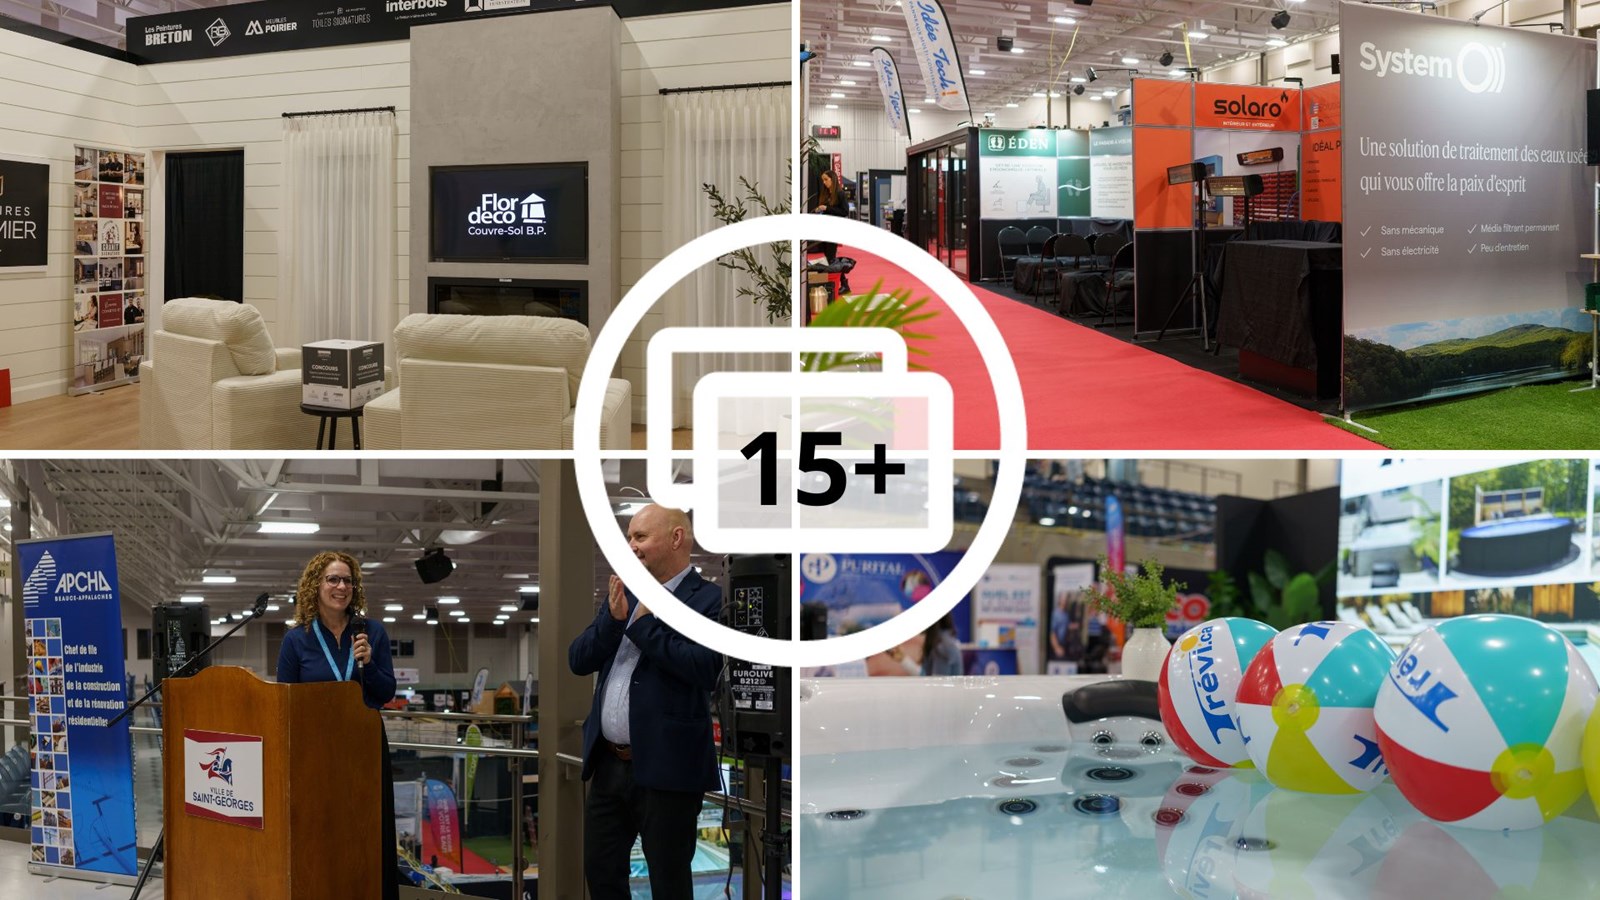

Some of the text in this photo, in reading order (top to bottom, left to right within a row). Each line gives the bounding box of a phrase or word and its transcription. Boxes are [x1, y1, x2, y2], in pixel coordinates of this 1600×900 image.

[312, 14, 370, 28] TOILES SIGNATURES
[917, 1, 939, 42] Idée
[156, 24, 182, 32] Peintures
[265, 22, 297, 33] POIRIER
[145, 29, 192, 46] BRETON
[1360, 42, 1452, 77] System
[1214, 94, 1281, 117] solaro
[1008, 135, 1049, 150] ÉDEN
[1313, 139, 1334, 152] IDÉAL
[1360, 137, 1588, 163] Une solution de traitement des eaux usée
[1360, 172, 1381, 195] qui
[1384, 176, 1414, 191] vous
[1416, 172, 1445, 191] offre
[1447, 173, 1457, 191] la
[1460, 174, 1484, 195] paix
[1487, 174, 1526, 196] d'esprit
[482, 193, 519, 211] Flor
[468, 206, 516, 224] deco
[468, 226, 547, 235] Couvre-Sol B.P.
[1381, 224, 1444, 236] Sans mécanique
[1481, 223, 1560, 233] Média filtrant permanent
[1381, 245, 1439, 256] Sans électricité
[1481, 243, 1529, 252] Peu d'entretien
[311, 364, 338, 372] CONCOURS
[55, 594, 112, 602] BEAUCE-APPALACHES
[64, 645, 97, 655] Chef de file
[65, 663, 103, 673] de l'industrie
[733, 670, 774, 678] EUROLIVE
[66, 681, 121, 692] de la construction
[67, 698, 124, 710] et de la rénovation
[210, 787, 234, 797] VILLE DE
[192, 792, 254, 812] SAINT-GEORGES
